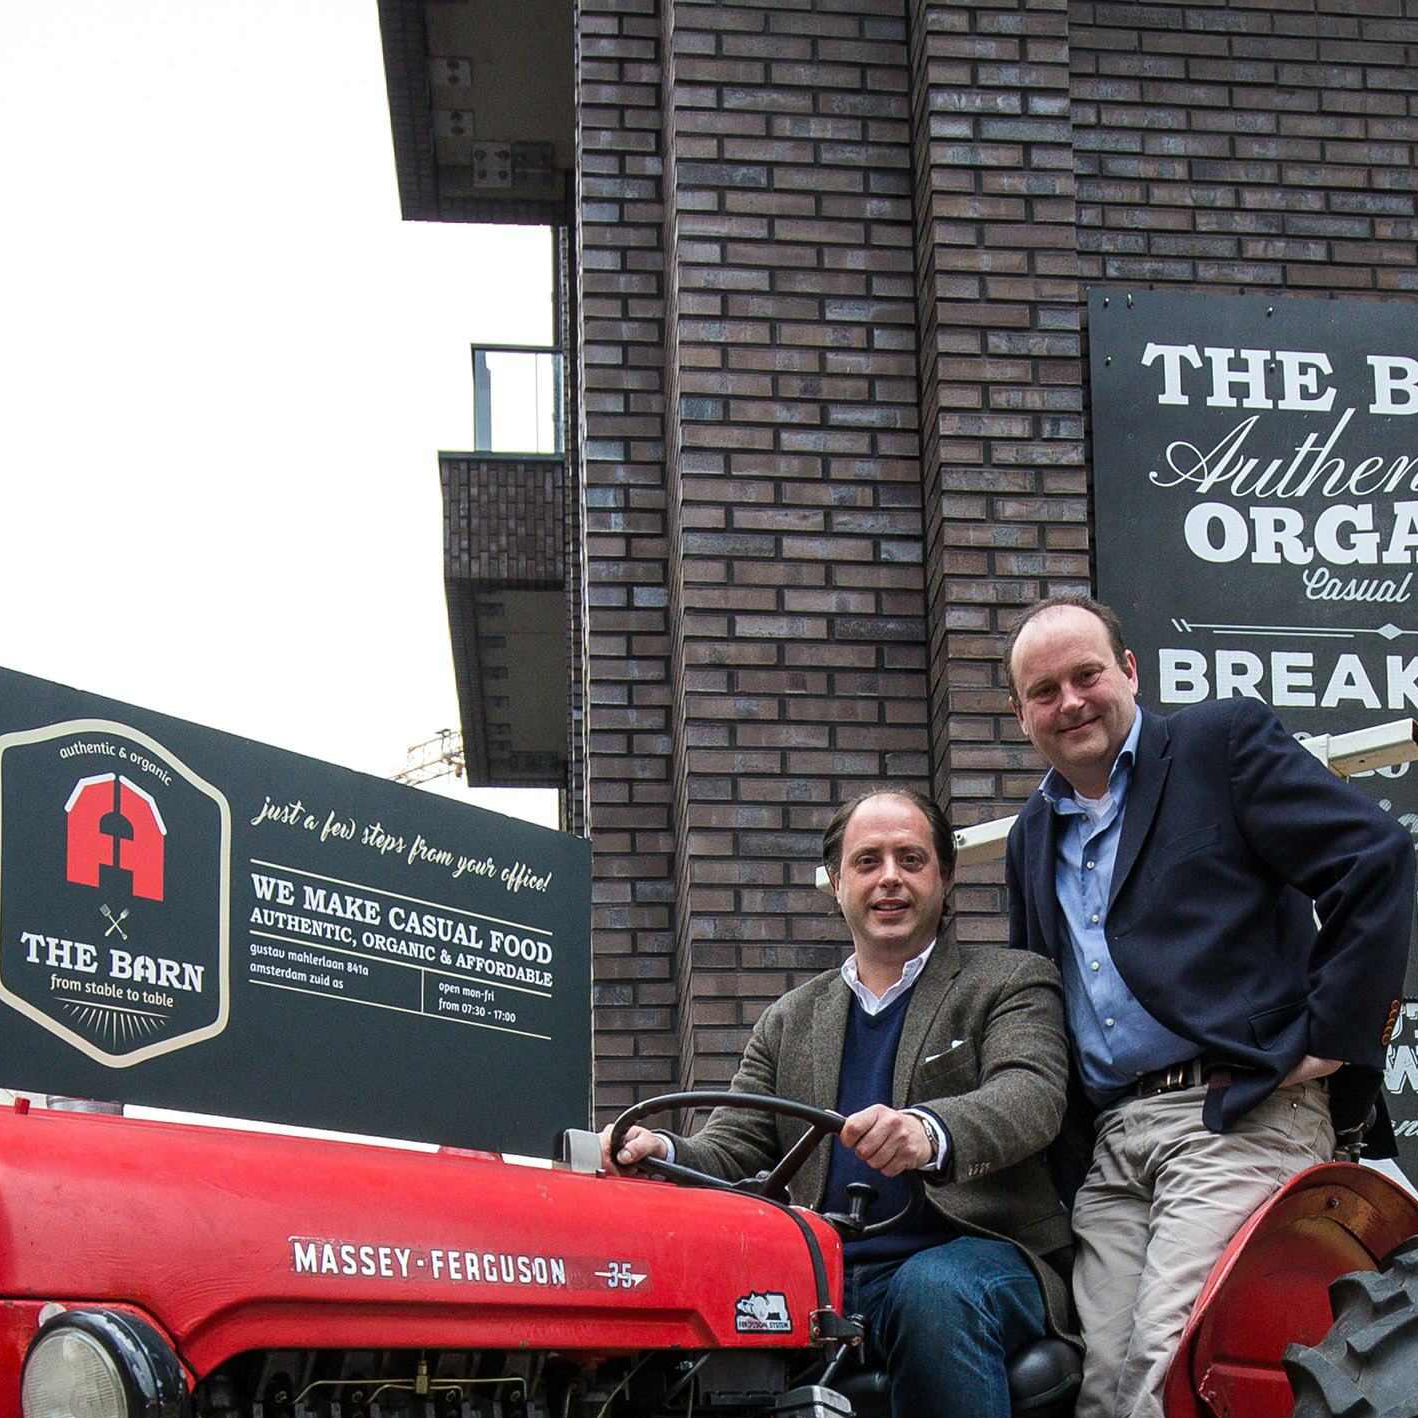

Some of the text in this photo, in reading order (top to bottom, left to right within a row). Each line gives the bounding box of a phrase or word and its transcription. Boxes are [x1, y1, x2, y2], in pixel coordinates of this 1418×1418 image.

[1141, 342, 1337, 411] THE
[1302, 567, 1414, 603] Casual
[59, 740, 172, 786] authentic & organic
[250, 796, 553, 893] just a few steps from your office!
[250, 873, 553, 965] WE MAKE CASUAL FOOD
[20, 931, 204, 992] THE BARN
[249, 907, 553, 987] AUTHENTIC, ORGANIC & AFFORDABLE
[249, 942, 369, 976] gustav mahlerlaan 841a
[50, 973, 174, 1007] from stable to table
[249, 962, 344, 990] amsterdam zuid as
[438, 982, 495, 1002] open mon-fri
[438, 997, 459, 1013] from
[461, 1003, 485, 1017] 07:30
[493, 1009, 516, 1023] 17:00
[607, 1262, 633, 1289] 35
